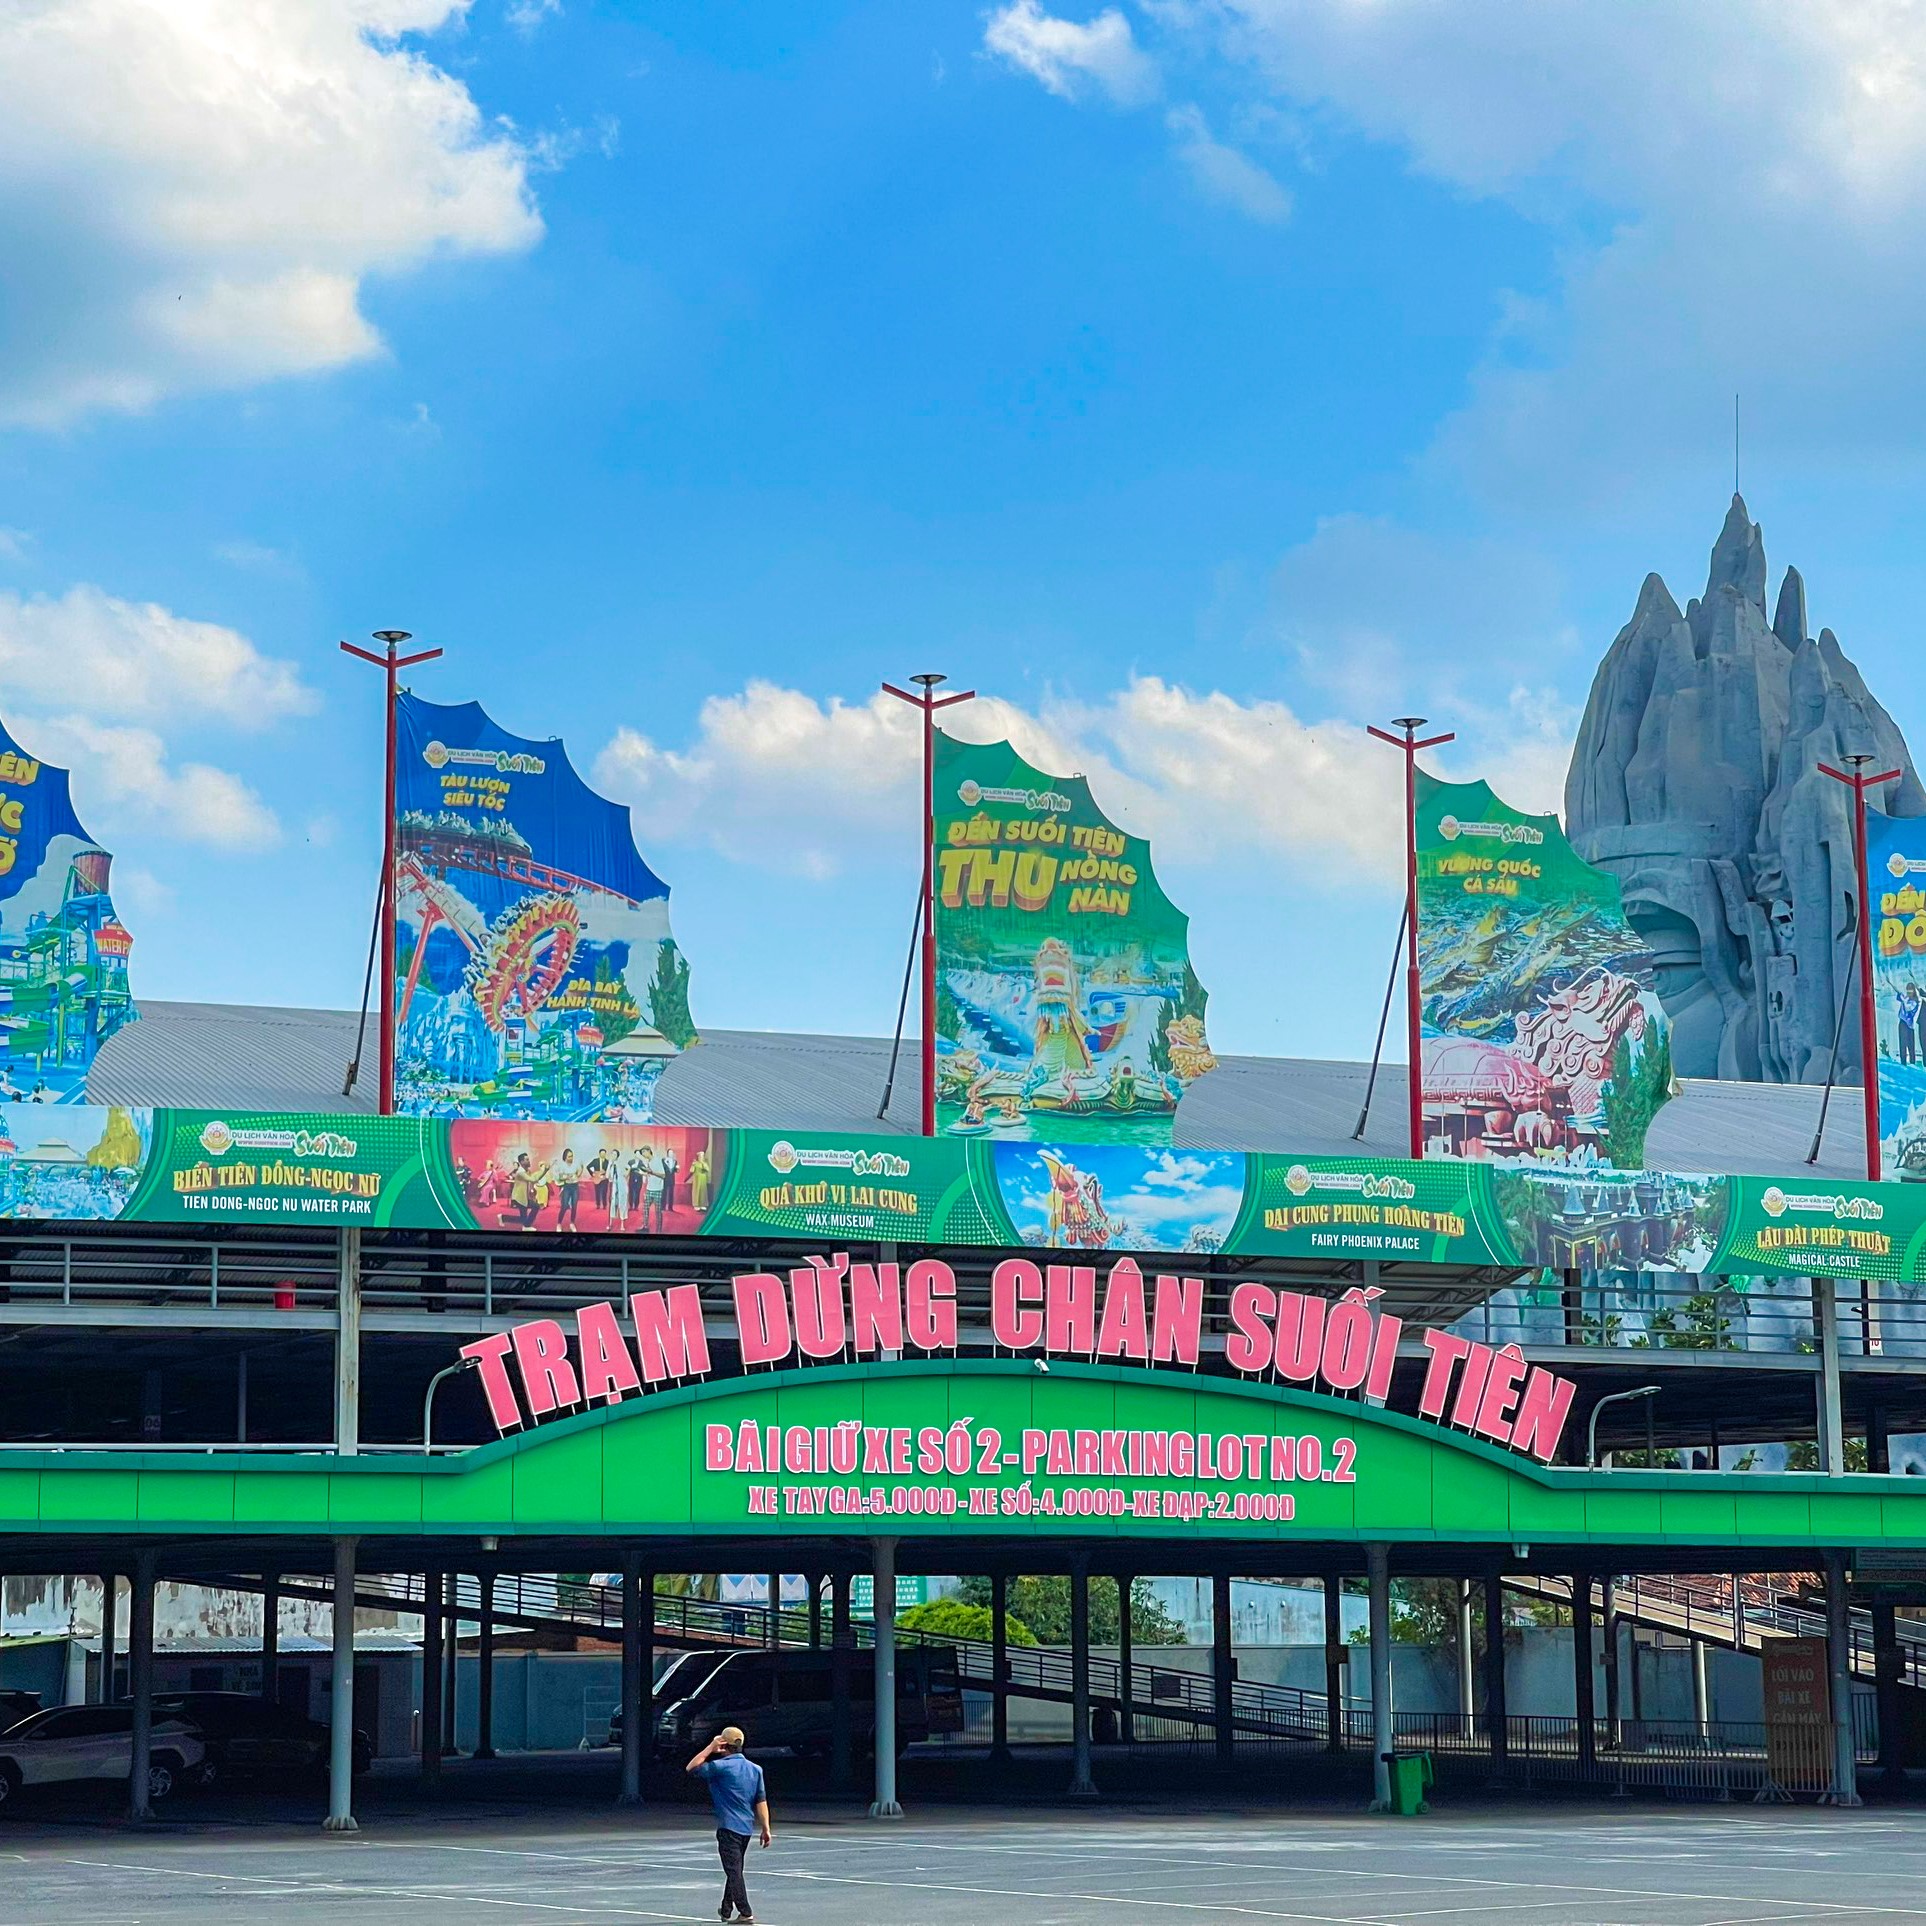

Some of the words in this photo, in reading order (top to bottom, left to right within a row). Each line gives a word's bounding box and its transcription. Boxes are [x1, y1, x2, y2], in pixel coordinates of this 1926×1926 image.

[441, 773, 468, 787] TÀU
[470, 777, 510, 794] LƯỢN
[443, 790, 474, 806] SIÊU
[478, 792, 505, 811] TỐC
[948, 811, 1001, 845] ĐẾN
[1004, 814, 1066, 843] SUỐI
[1070, 826, 1126, 857] TIÊN
[939, 849, 1058, 911] THU
[1059, 850, 1137, 887] NỒNG
[1438, 856, 1493, 874] VƯƠNG
[1497, 858, 1541, 878] QUỐC
[1068, 882, 1130, 916] NÀN
[1463, 874, 1483, 893] CÁ
[1487, 875, 1518, 895] SẤU
[173, 1161, 213, 1192] BIỂN
[218, 1161, 256, 1187] TIÊN
[358, 1173, 382, 1197] NỮ
[183, 1196, 208, 1209] TIEN
[212, 1196, 278, 1211] DONG-NGOC
[282, 1198, 298, 1212] NU
[302, 1199, 338, 1213] WATER
[342, 1200, 372, 1214] PARK
[760, 1182, 790, 1210] QUÁ
[831, 1185, 846, 1207] VỊ
[851, 1186, 874, 1206] LAI
[879, 1189, 917, 1214] CUNG
[806, 1213, 828, 1226] WAX
[830, 1214, 874, 1228] MUSEUM
[1264, 1207, 1289, 1231] ĐẠI
[1293, 1205, 1328, 1225] CUNG
[1333, 1204, 1380, 1226] PHỤNG
[1434, 1212, 1465, 1236] TIÊN
[1312, 1233, 1338, 1246] FAIRY
[1342, 1234, 1382, 1248] PHOENIX
[1385, 1236, 1420, 1250] PALACE
[1756, 1226, 1781, 1250] LÂU
[1785, 1224, 1807, 1245] ĐÀI
[1811, 1224, 1845, 1246] PHÉP
[1848, 1230, 1890, 1254] THUẬT
[1788, 1254, 1826, 1266] MAGICAL
[1830, 1255, 1860, 1268] CASTLE
[459, 1283, 712, 1431] TRẠM
[731, 1251, 958, 1365] DỪNG
[990, 1256, 1204, 1365] CHÂN
[1224, 1281, 1402, 1401] SUỐI
[1420, 1326, 1577, 1464] TIÊN
[705, 1418, 780, 1472] BÃI
[784, 1420, 862, 1474] GIỮ
[863, 1427, 913, 1474] XE
[918, 1417, 974, 1475] SỐ
[1198, 1434, 1267, 1481] LOT
[1270, 1434, 1357, 1482] NO.2
[748, 1486, 778, 1514] XE
[783, 1486, 828, 1514] TAY
